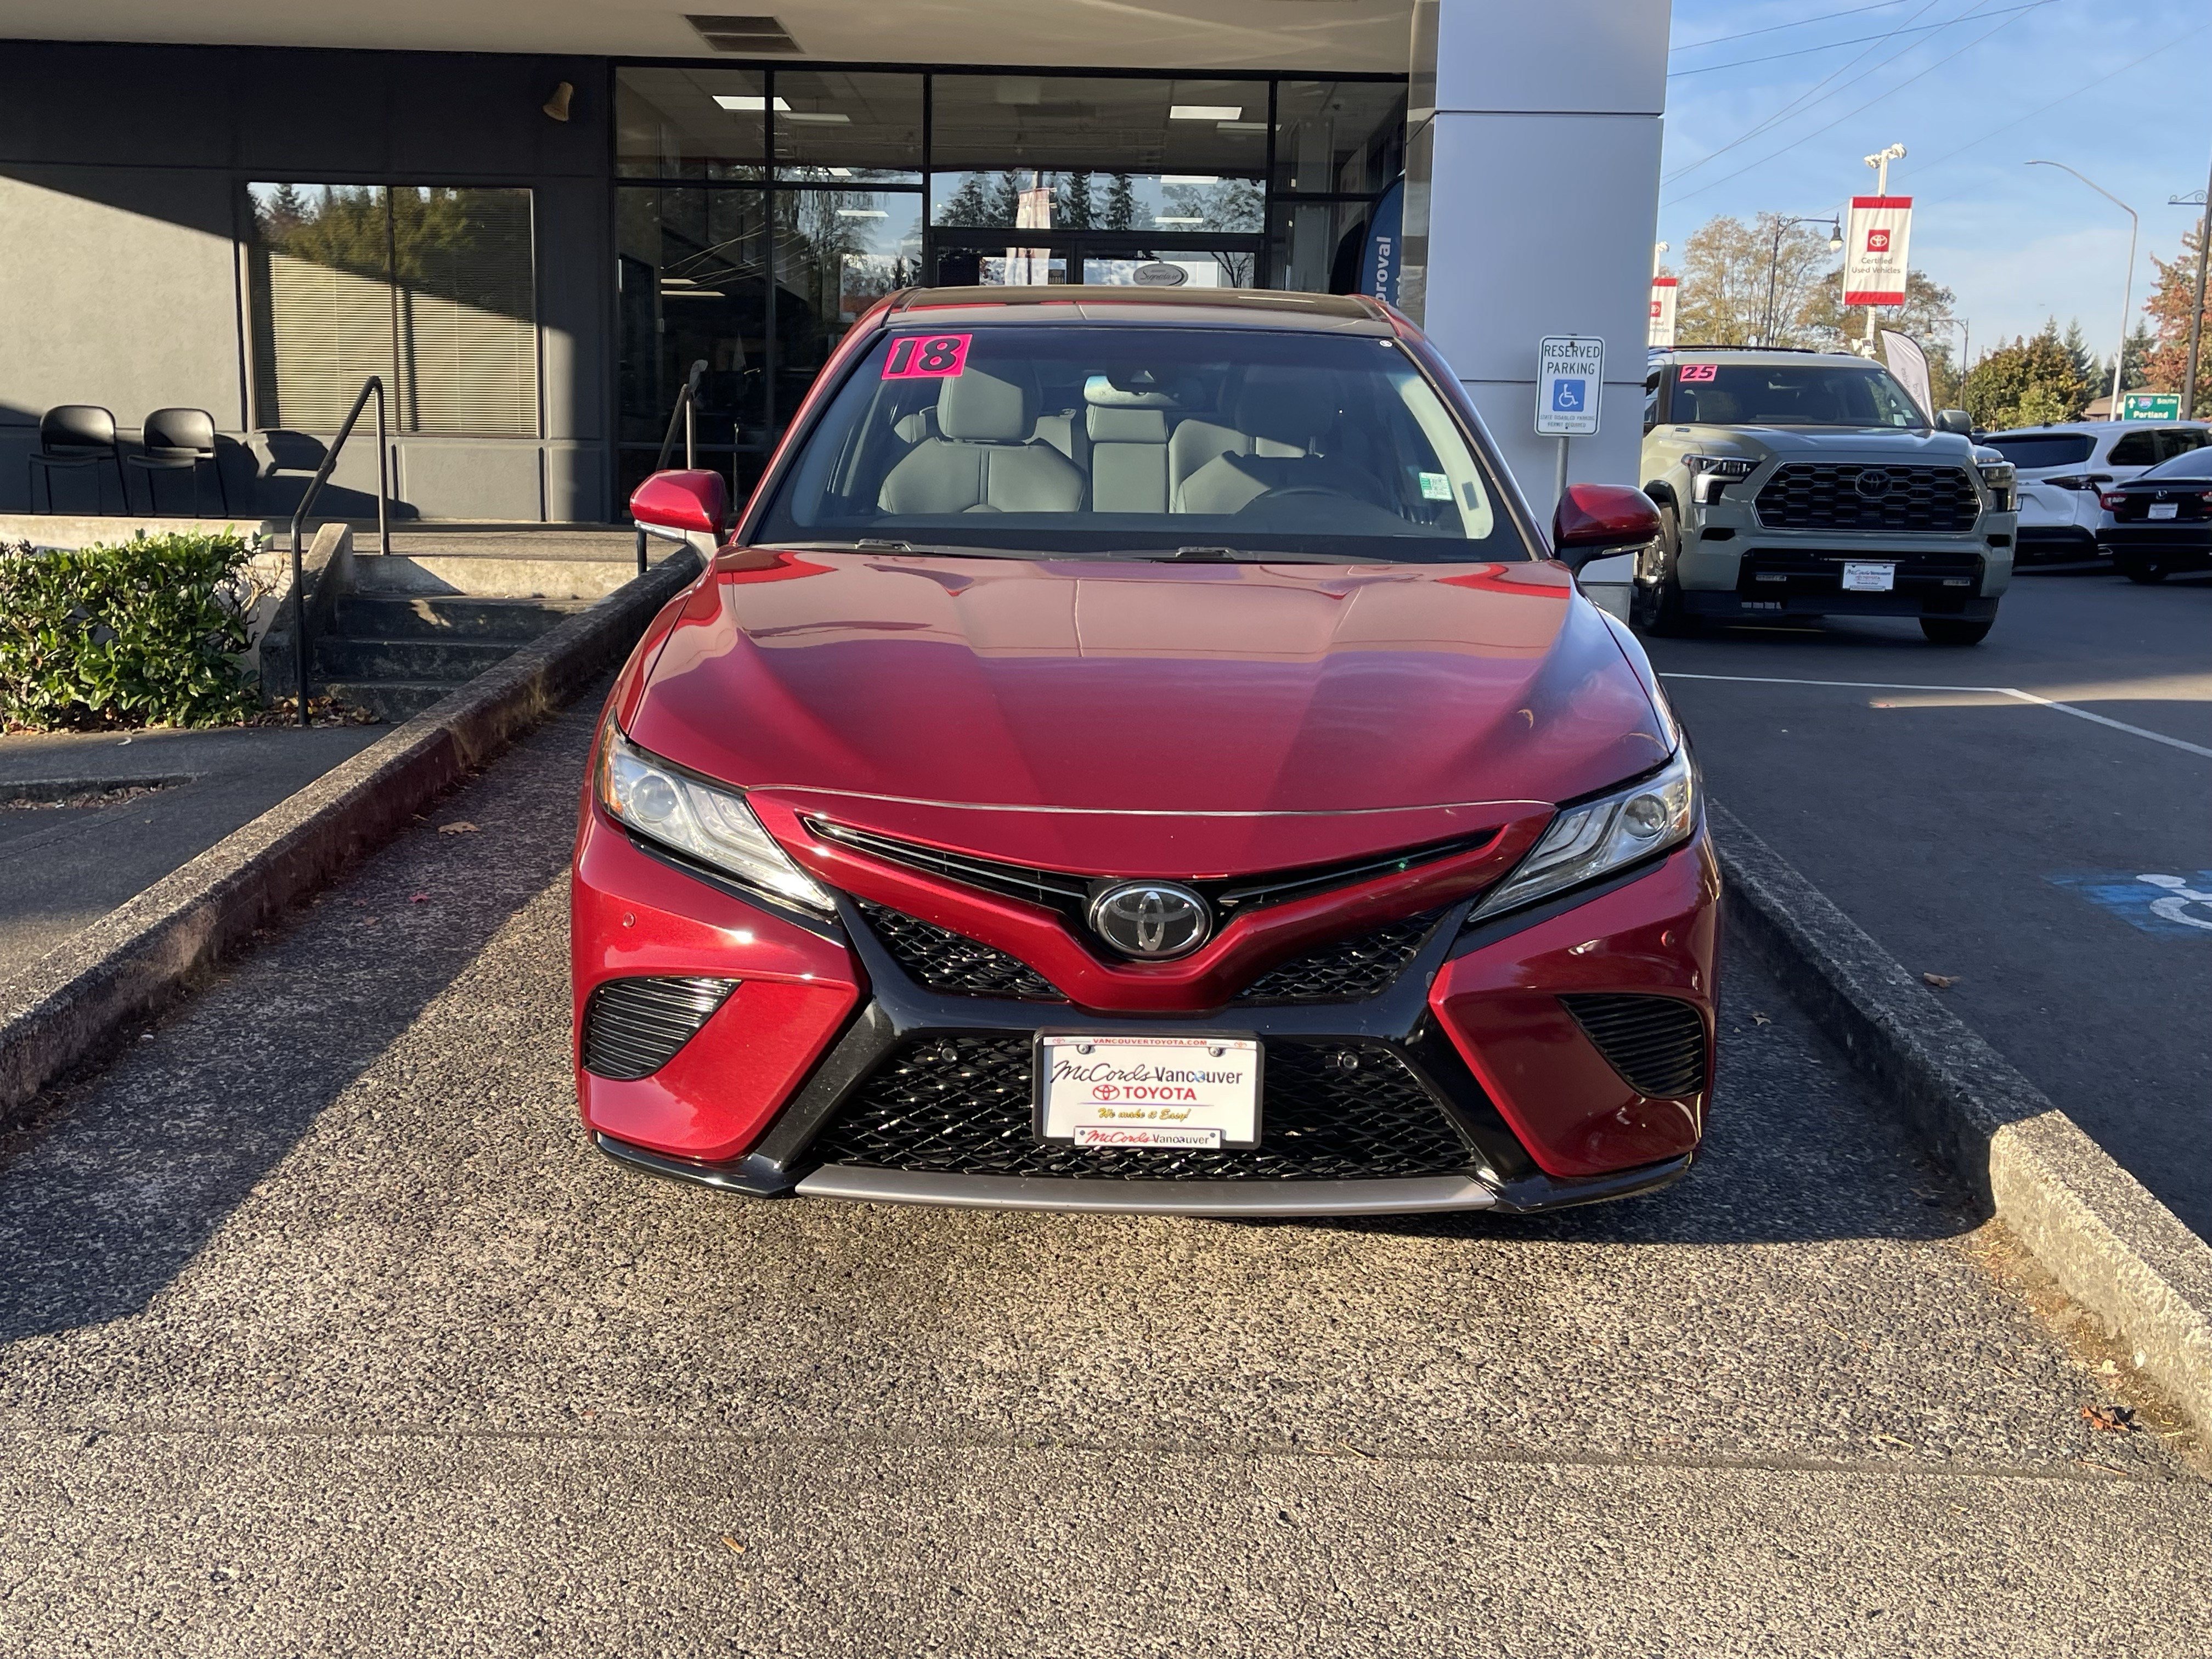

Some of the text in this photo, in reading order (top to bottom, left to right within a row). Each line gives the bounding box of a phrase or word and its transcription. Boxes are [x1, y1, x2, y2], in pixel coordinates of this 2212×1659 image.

[888, 338, 961, 374] 18
[1544, 345, 1600, 358] RESERVED
[1547, 362, 1595, 375] PARKING
[1683, 366, 1714, 379] 25
[2133, 410, 2169, 419] Portland
[1155, 1066, 1243, 1084] Vancouver
[1123, 1086, 1197, 1101] TOYOTA
[1098, 1108, 1115, 1118] We
[1118, 1108, 1145, 1118] make
[1159, 1108, 1192, 1122] Easy!
[1153, 1133, 1210, 1144] Vancouver
